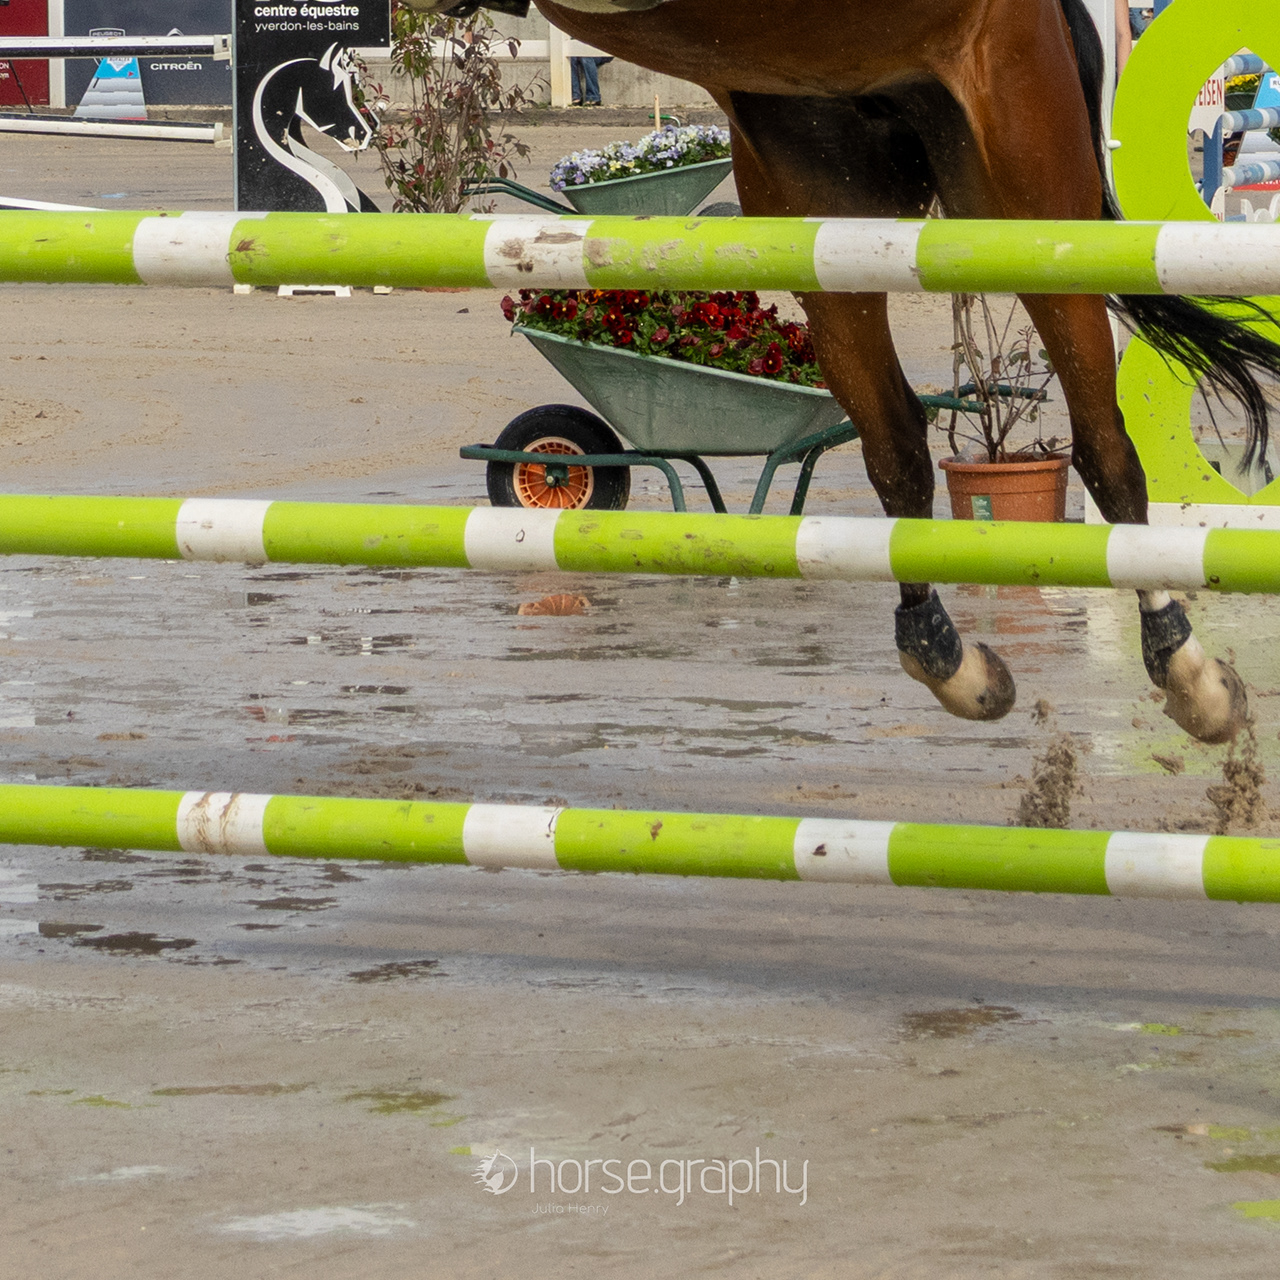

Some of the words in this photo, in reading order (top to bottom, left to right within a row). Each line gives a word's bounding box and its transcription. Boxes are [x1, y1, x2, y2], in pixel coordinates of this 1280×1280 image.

[255, 5, 298, 17] centre
[301, 4, 359, 20] équestre
[255, 21, 360, 33] yverdon-les-bains
